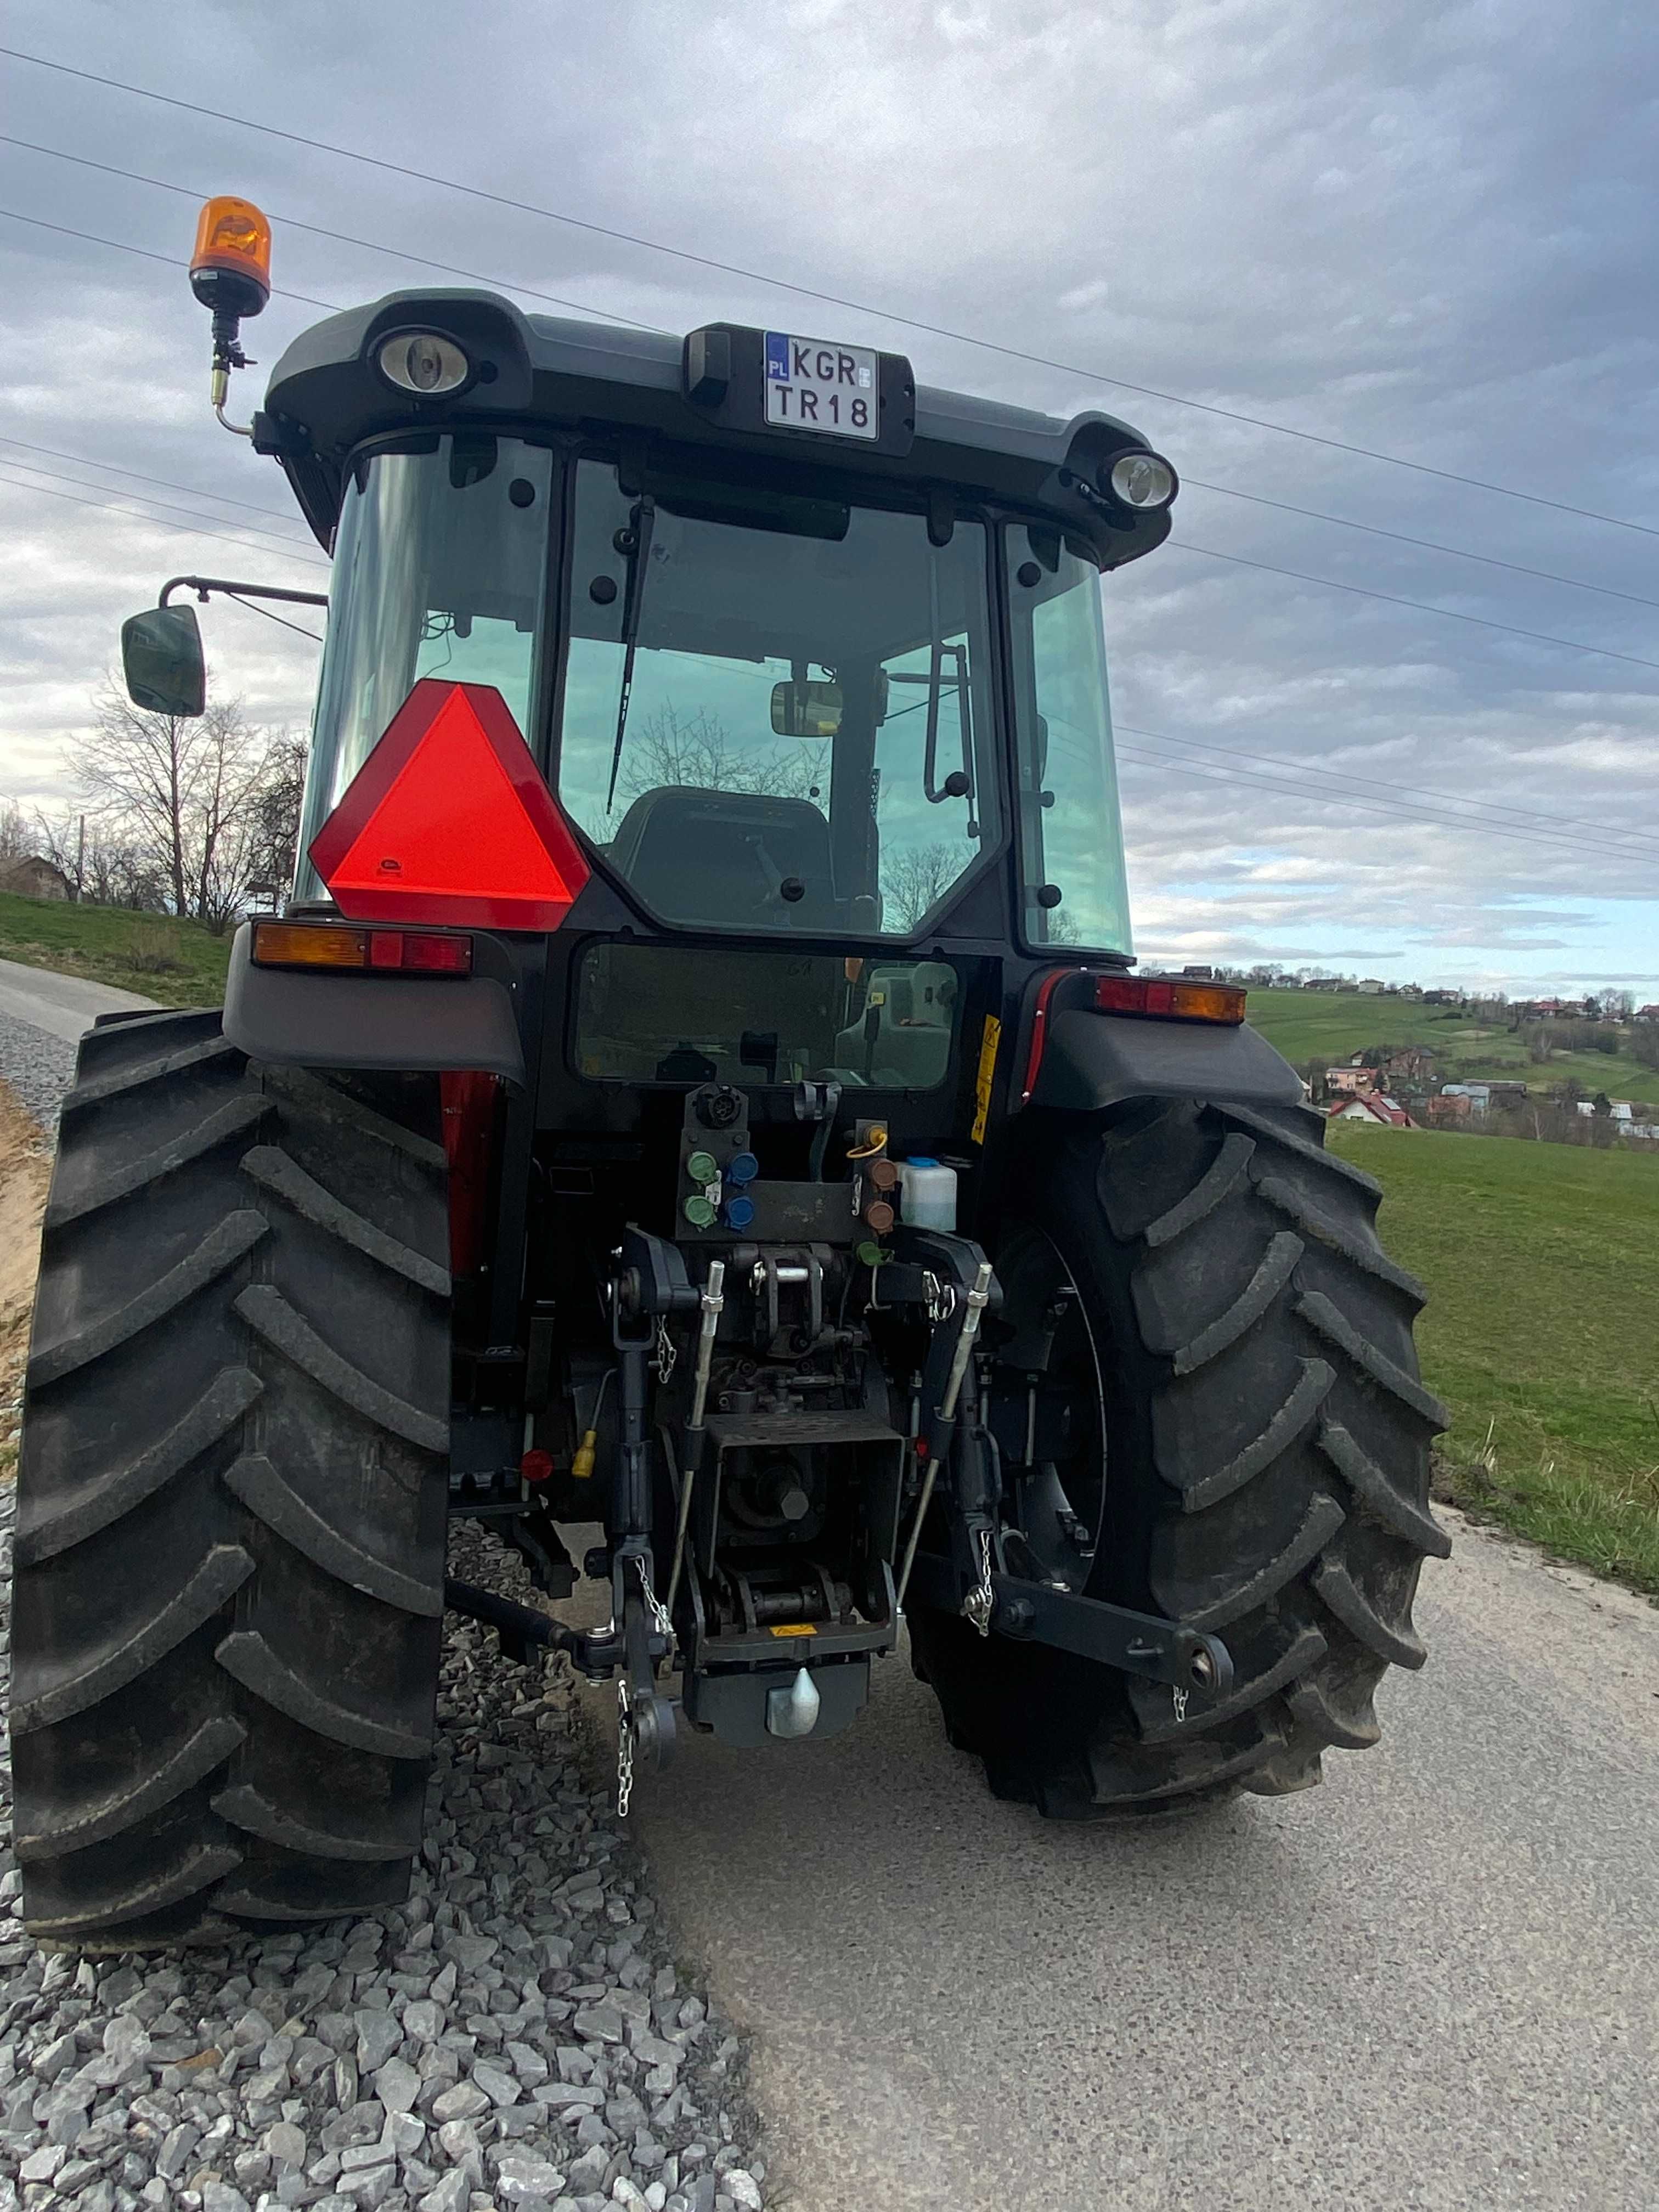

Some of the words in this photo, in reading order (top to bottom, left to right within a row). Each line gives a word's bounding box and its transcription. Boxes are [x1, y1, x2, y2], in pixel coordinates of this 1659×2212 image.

[769, 360, 788, 377] PL
[794, 343, 855, 386] KGR
[775, 385, 868, 427] TR18
